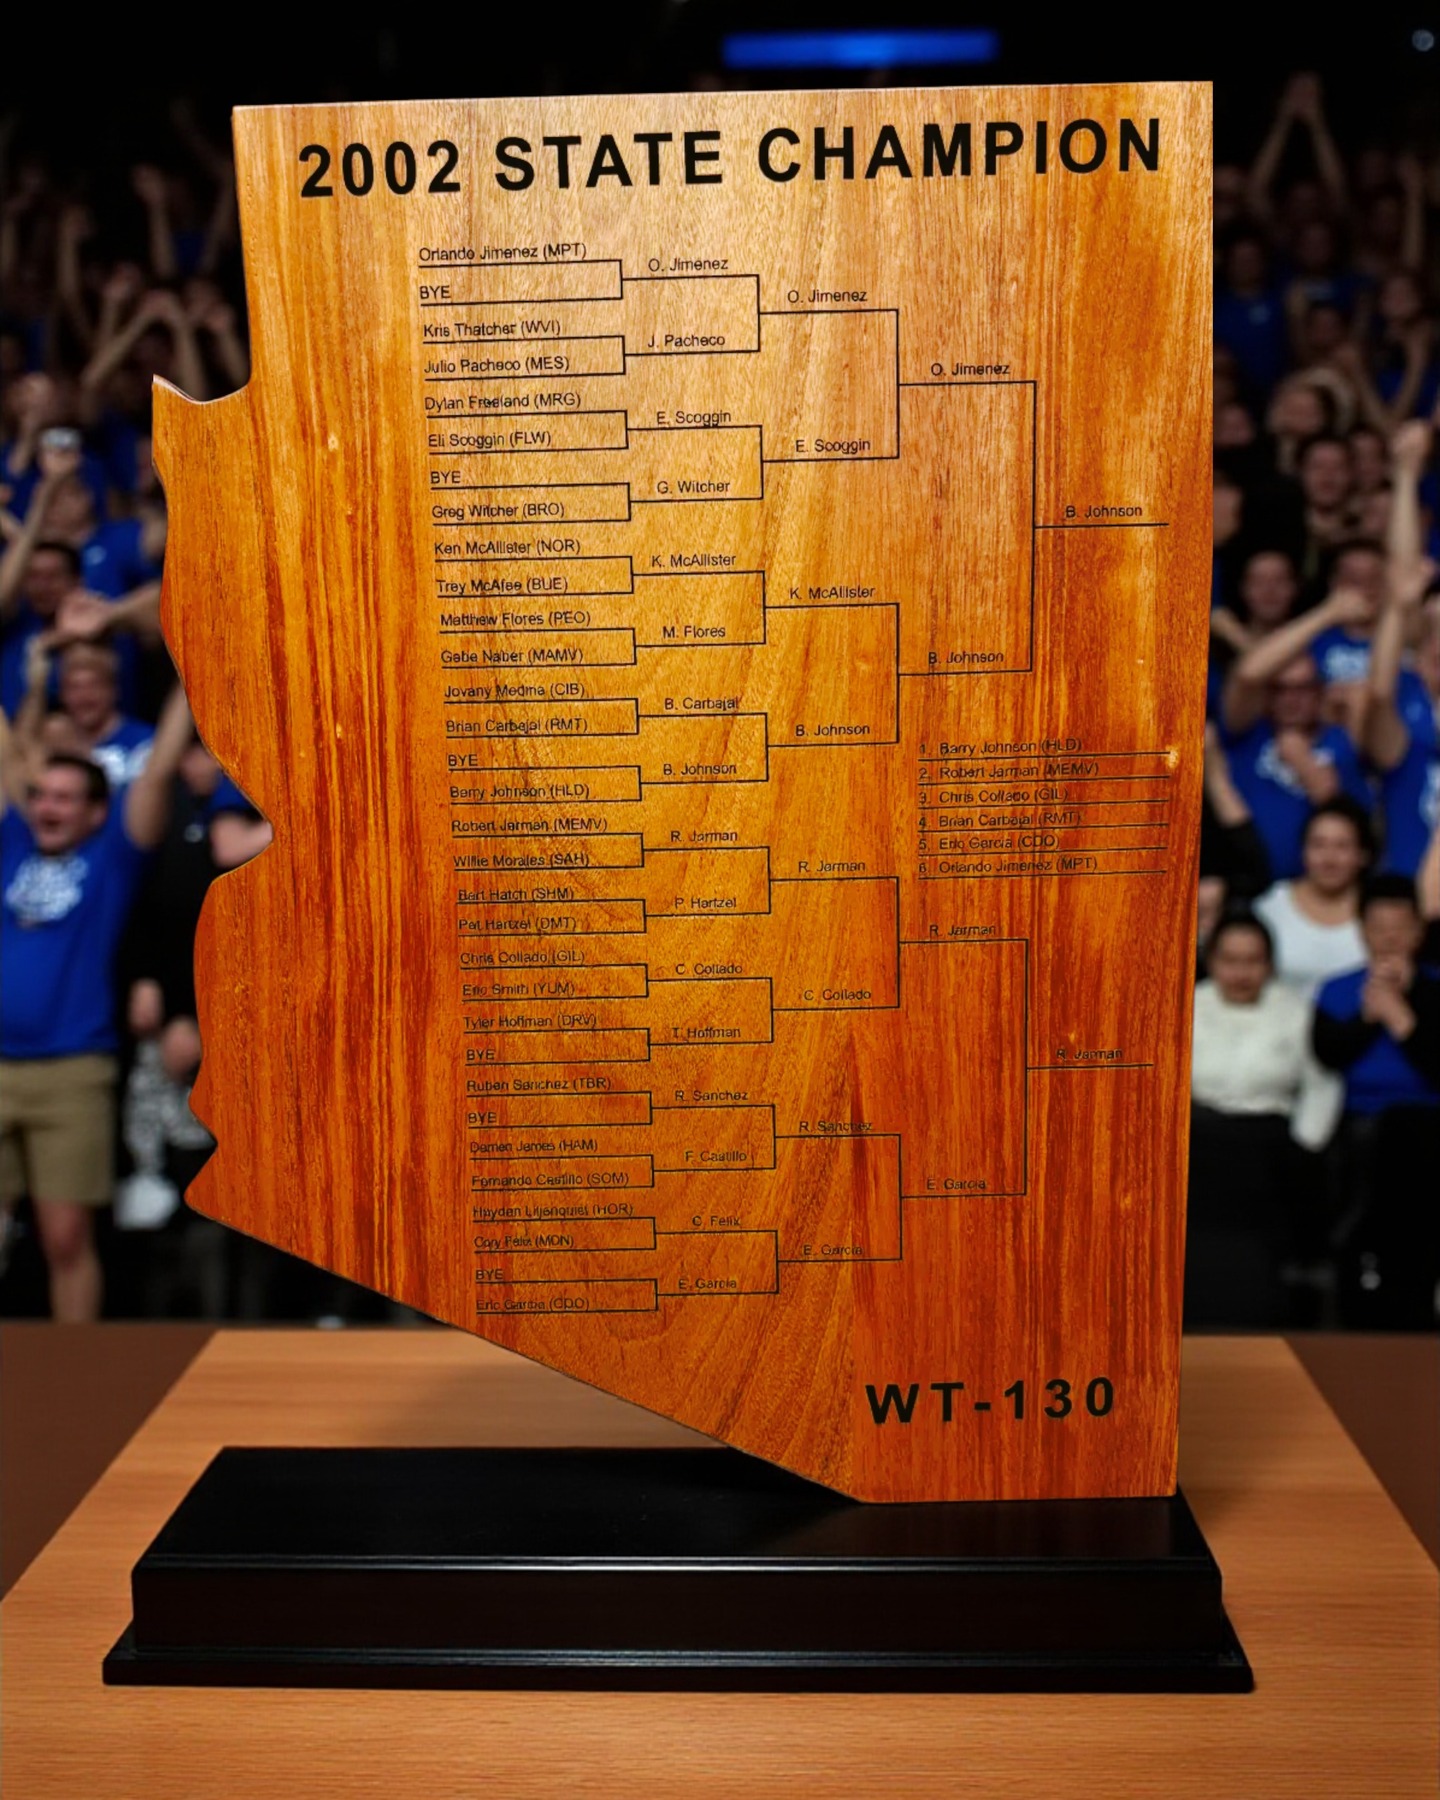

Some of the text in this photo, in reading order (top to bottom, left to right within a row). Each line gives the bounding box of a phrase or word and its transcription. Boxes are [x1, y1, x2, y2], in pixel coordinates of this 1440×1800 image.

[300, 118, 1159, 198] 2002 STATE CHAMPION
[480, 245, 538, 260] Jimenez
[543, 243, 586, 259] (MPT)
[648, 258, 728, 272] O. Jimenez
[420, 285, 450, 299] BYE
[788, 289, 867, 303] O. Jimenez
[423, 320, 560, 337] Kris Thatcher (WVI)
[648, 334, 725, 348] J. Pacheco
[424, 356, 569, 374] Julio Pacheco (MES)
[931, 363, 1010, 376] O. Jimenez
[534, 392, 581, 409] (MRG)
[657, 410, 731, 426] E. Scoggin
[428, 434, 445, 447] Eli
[510, 431, 551, 447] (FLW)
[796, 438, 870, 454] E. Scoggin
[430, 471, 461, 483] BYE
[657, 480, 730, 494] G. Witcher
[432, 503, 564, 520] Greg Witcher (BRO)
[1066, 505, 1142, 518] B. Johnson
[434, 539, 580, 555] Ken McAllister (NOR)
[652, 554, 736, 567] K. McAllister
[436, 580, 465, 594] Trey
[527, 577, 568, 592] (BUE)
[790, 586, 875, 599] K. McAllister
[503, 612, 544, 625] Flores
[549, 611, 591, 627] (PEO)
[663, 625, 725, 638] M. Flores
[528, 648, 583, 665] (MAMV)
[928, 651, 1004, 664] B. Johnson
[445, 685, 491, 699] Jovany
[551, 683, 585, 698] (CIB)
[665, 697, 739, 711] B. Carbajal
[446, 721, 481, 732] Brian
[546, 718, 587, 732] (RMT)
[796, 724, 870, 736] B. Johnson
[448, 754, 477, 766] BYE
[663, 763, 737, 775] B. Johnson
[550, 783, 590, 799] (HLD)
[940, 792, 973, 803] Chris
[550, 853, 589, 867] (SAH)
[466, 1050, 495, 1060] BYE
[468, 1113, 496, 1123] BYE
[476, 1270, 503, 1280] BYE
